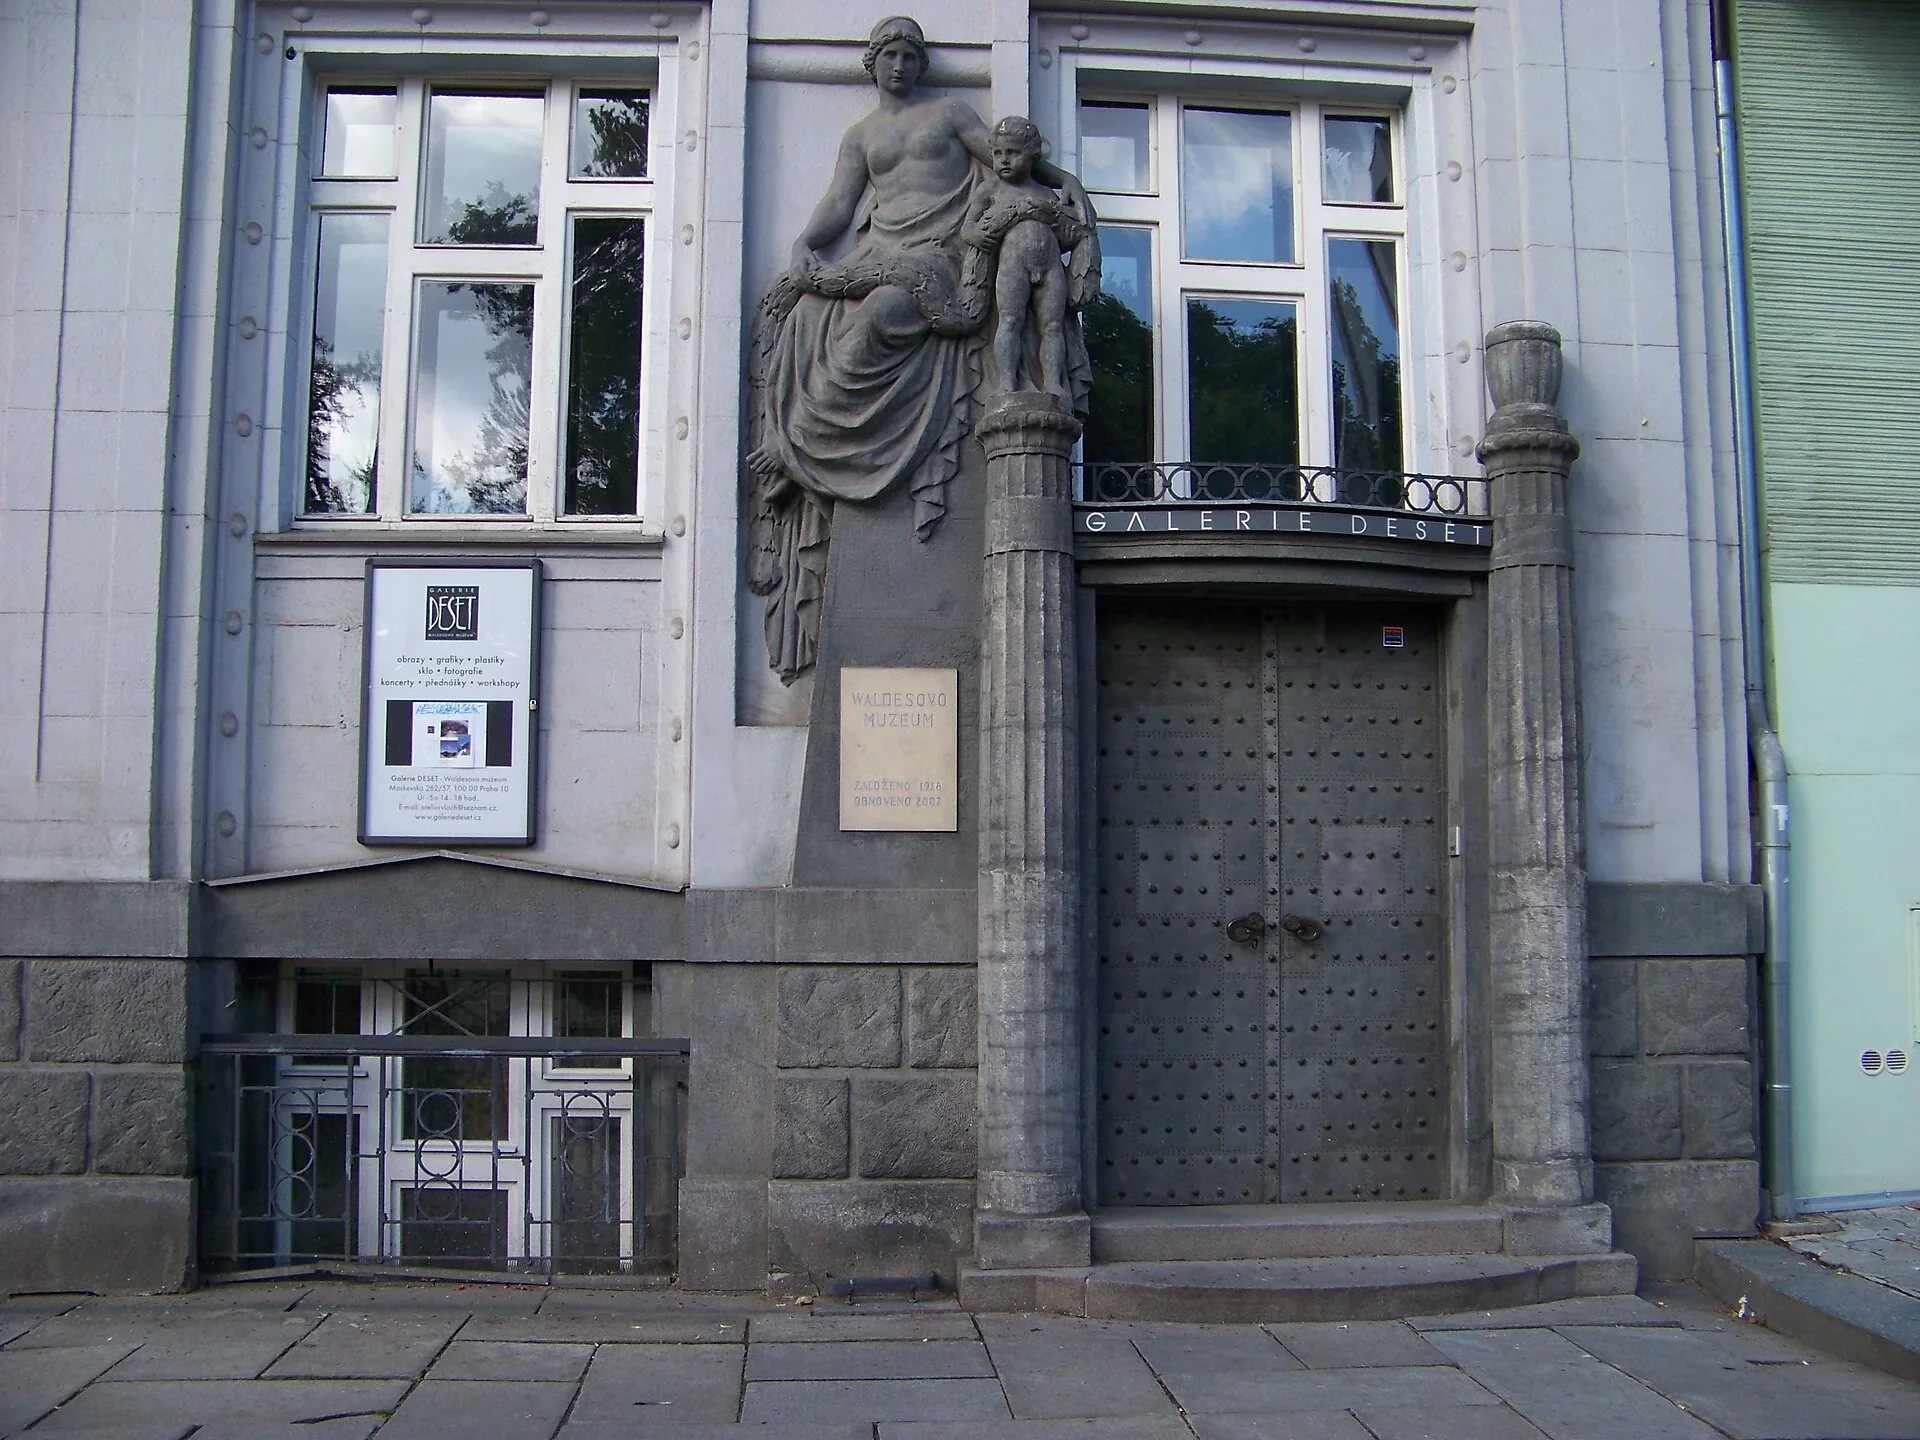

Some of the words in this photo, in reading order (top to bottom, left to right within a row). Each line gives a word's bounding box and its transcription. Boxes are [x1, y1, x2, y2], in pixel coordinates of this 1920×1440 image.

[1085, 509, 1313, 532] GALERIE
[1351, 514, 1483, 545] DESET
[428, 595, 477, 631] DESET
[397, 655, 425, 665] obrazy
[436, 655, 464, 665] grafiky
[474, 655, 505, 665] plastiky
[418, 666, 434, 675] sklo
[444, 666, 483, 676] fotografie
[380, 678, 415, 688] koncerty
[425, 678, 467, 688] přednášky
[477, 679, 521, 688] workshopy
[851, 692, 948, 707] WALDESOVO
[863, 713, 935, 728] MUZEUM
[390, 774, 416, 782] Galerie
[443, 775, 480, 783] Waldesovo
[853, 777, 912, 791] ZALOŽENO
[853, 796, 912, 806] OBNOVENO
[414, 813, 482, 821] www.galeriedeset.cz
